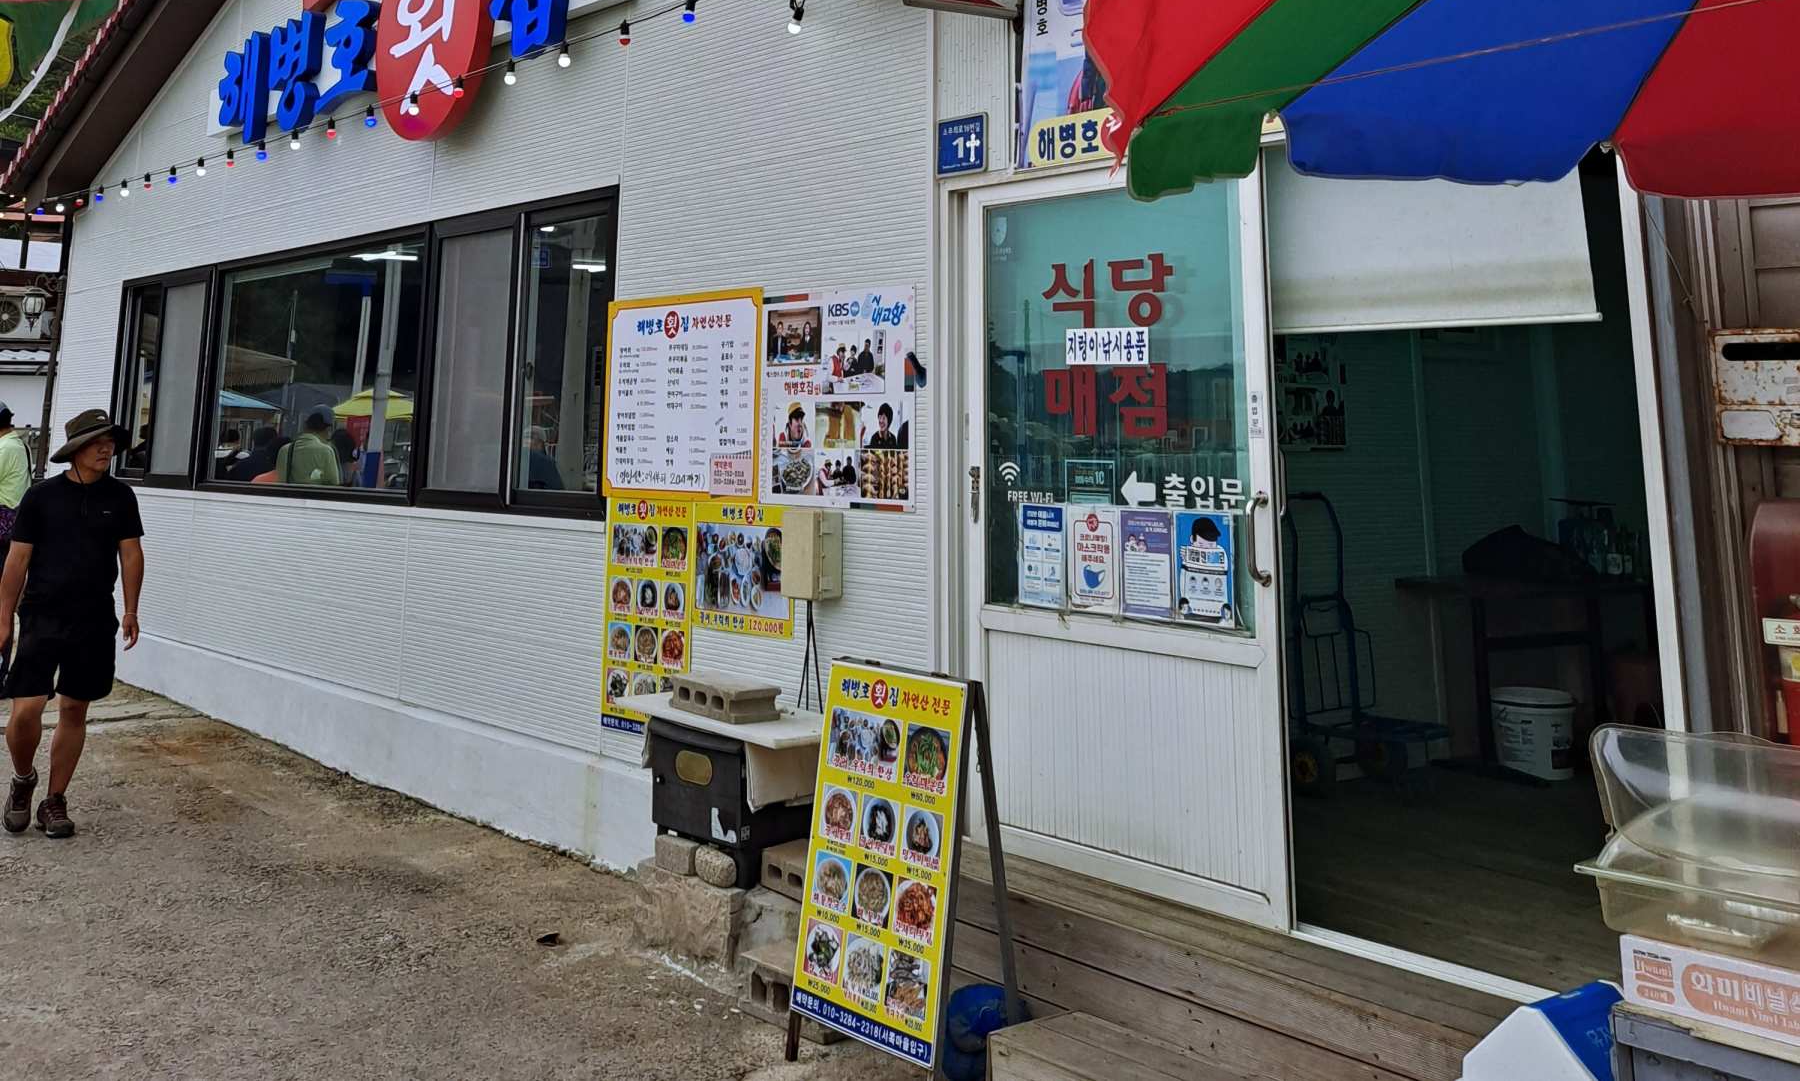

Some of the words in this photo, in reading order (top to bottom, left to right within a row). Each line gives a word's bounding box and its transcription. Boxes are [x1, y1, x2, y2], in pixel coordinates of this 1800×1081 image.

[1037, 118, 1099, 161] 해병호
[1042, 252, 1175, 328] 식당
[827, 302, 850, 318] KBS
[871, 301, 907, 326] 내고향
[636, 318, 664, 336] 해병호
[691, 313, 733, 330] 자연산전문
[1042, 363, 1169, 439] 매점
[1007, 490, 1029, 503] FREE
[1030, 491, 1055, 504] WI-FI
[1162, 473, 1246, 516] 출입문
[617, 502, 636, 516] 해병호
[1076, 542, 1111, 555] 마스크착용
[841, 678, 871, 699] 해병호
[901, 690, 929, 712] 자연산
[930, 696, 952, 716] 전문
